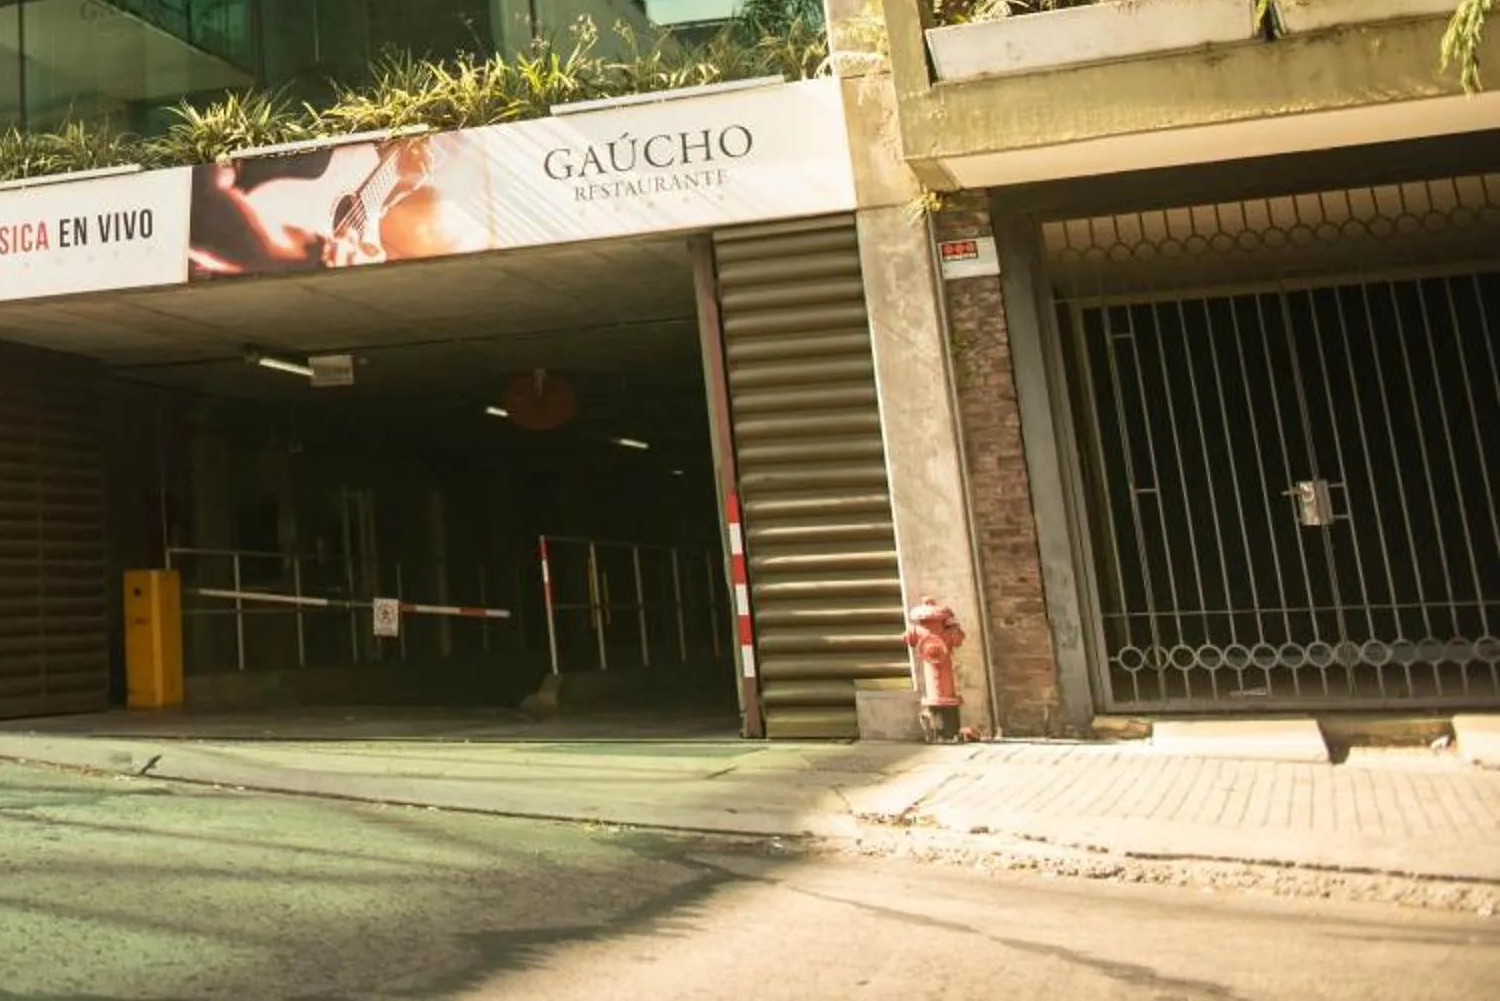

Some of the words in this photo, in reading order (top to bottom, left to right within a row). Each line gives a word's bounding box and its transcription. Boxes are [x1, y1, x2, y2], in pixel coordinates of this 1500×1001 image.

[544, 124, 753, 181] GAÚCHO
[574, 168, 729, 202] RESTAURANTE
[59, 216, 88, 248] EN
[98, 208, 154, 244] VIVO
